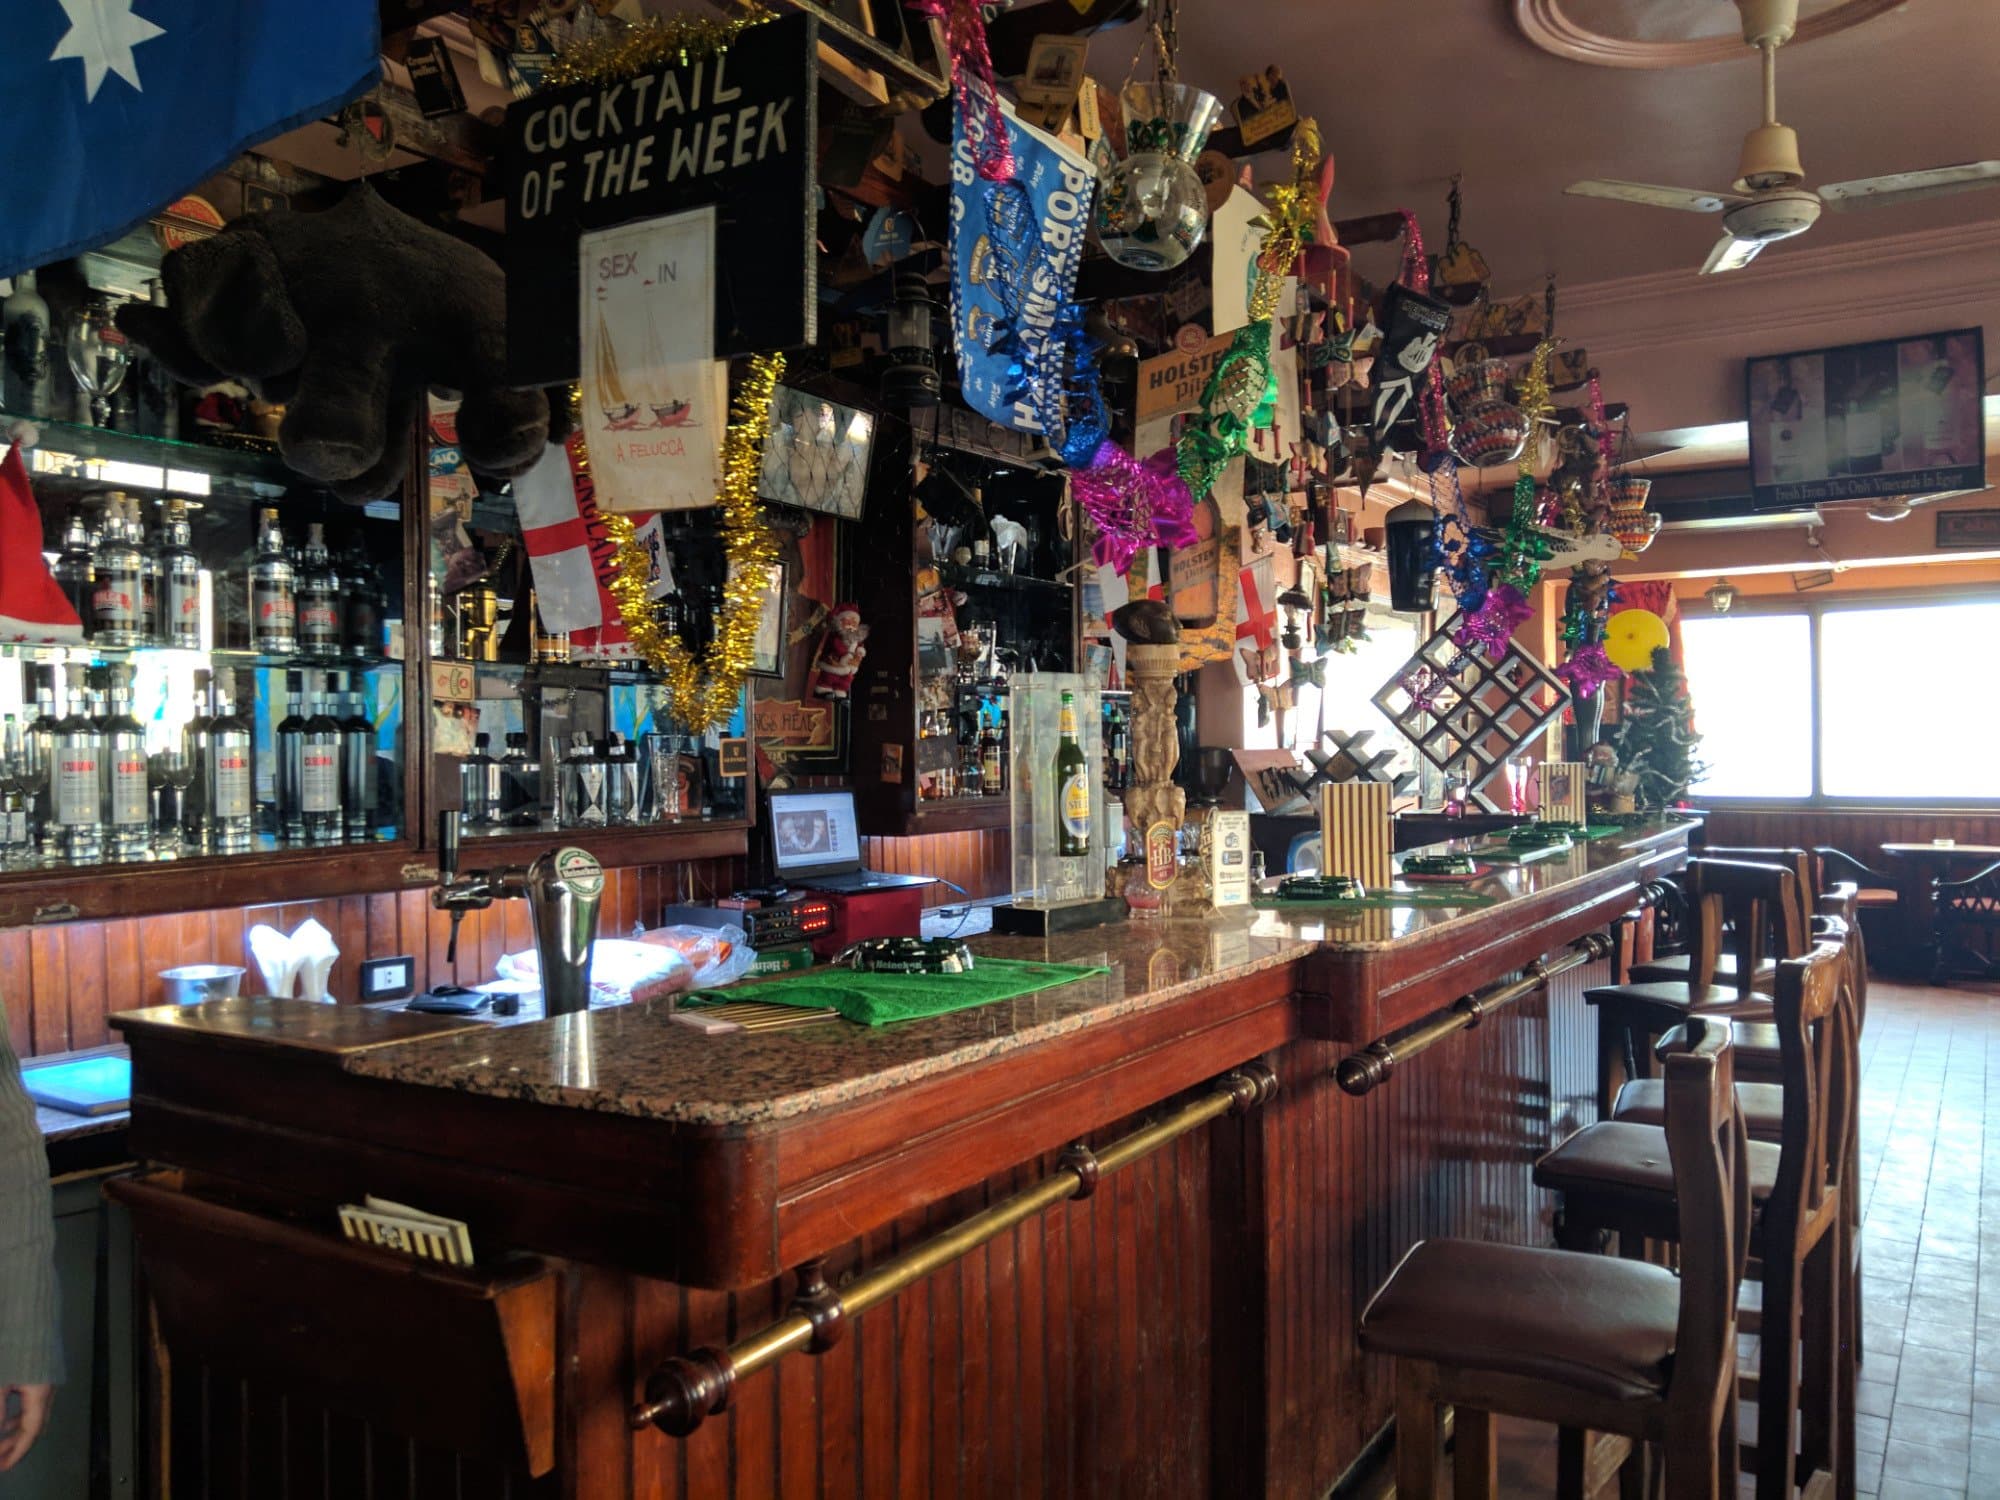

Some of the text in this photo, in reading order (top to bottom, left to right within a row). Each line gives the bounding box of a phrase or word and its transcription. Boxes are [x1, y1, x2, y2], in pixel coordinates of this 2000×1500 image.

[522, 53, 742, 155] COCKTAIL
[520, 96, 794, 221] OF THE WEEK
[598, 250, 677, 282] SEX IN
[616, 435, 685, 463] A FELUCCA
[1801, 483, 1826, 499] From
[1828, 480, 1846, 497] The
[1848, 479, 1870, 495] Only
[1873, 475, 1922, 494] Vineyards
[1152, 846, 1172, 866] HB
[875, 958, 923, 970] Heineken
